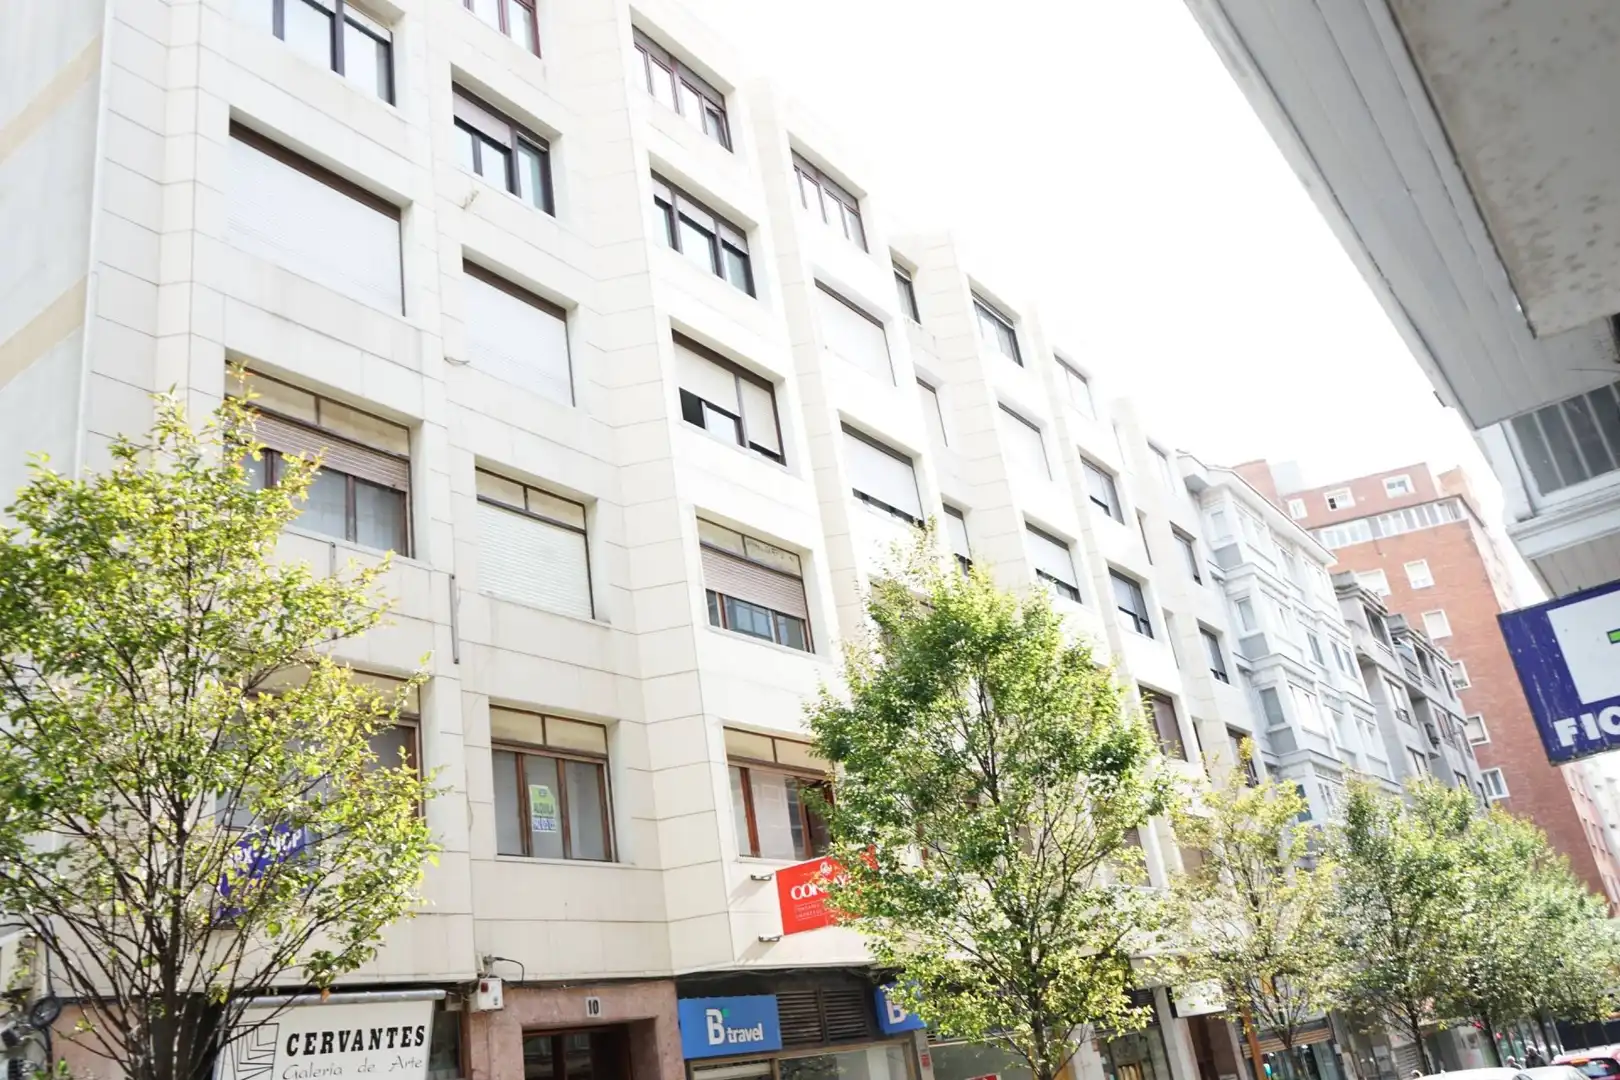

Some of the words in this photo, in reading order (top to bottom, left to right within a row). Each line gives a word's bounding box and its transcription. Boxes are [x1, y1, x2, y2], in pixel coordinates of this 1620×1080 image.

[588, 1000, 599, 1015] 10
[706, 1009, 726, 1045] B
[727, 1023, 764, 1043] travel
[286, 1025, 425, 1057] CERVANTES
[357, 1057, 376, 1072] de
[388, 1055, 422, 1072] Arte
